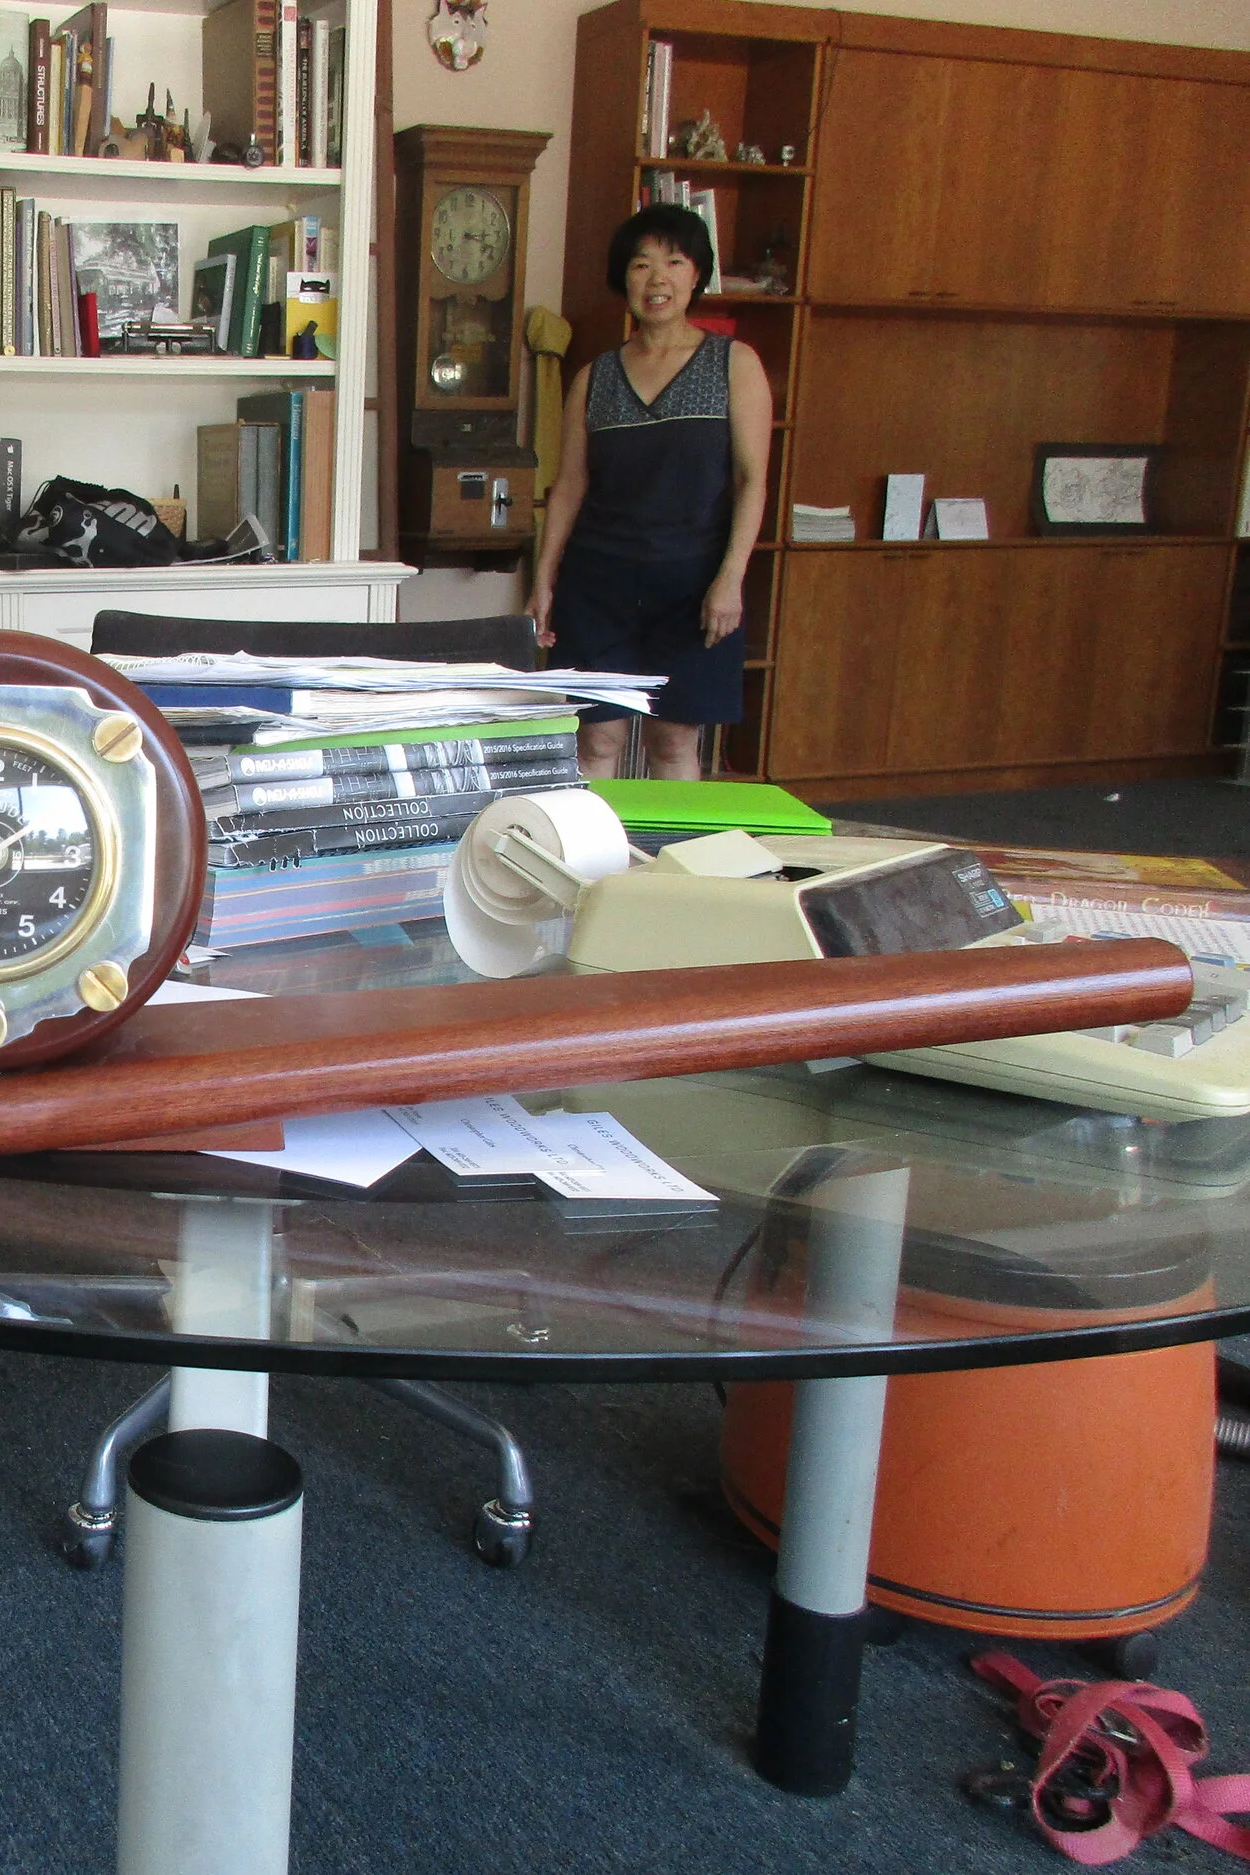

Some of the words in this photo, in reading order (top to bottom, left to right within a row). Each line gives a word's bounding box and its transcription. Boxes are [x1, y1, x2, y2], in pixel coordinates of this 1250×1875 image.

[36, 65, 46, 125] STRUCTURES
[6, 475, 14, 486] OS
[4, 492, 14, 512] Tiger
[483, 743, 512, 754] 2015/2016
[512, 741, 547, 753] Specification
[547, 741, 564, 750] Guide
[12, 760, 33, 773] FEET
[490, 769, 518, 780] 2015/2016
[517, 767, 552, 778] Specification
[552, 766, 569, 775] Guide
[31, 772, 39, 795] 1
[342, 801, 429, 821] COLLECTION
[354, 822, 439, 843] COLLECTION
[63, 845, 82, 869] 3
[957, 868, 982, 883] SHARP
[49, 886, 67, 909] 4
[17, 914, 36, 938] 5
[483, 1097, 505, 1112] ILES
[500, 1112, 552, 1154] WOODWORKS
[587, 1118, 613, 1139] GILES
[608, 1139, 667, 1181] WOODWORKS
